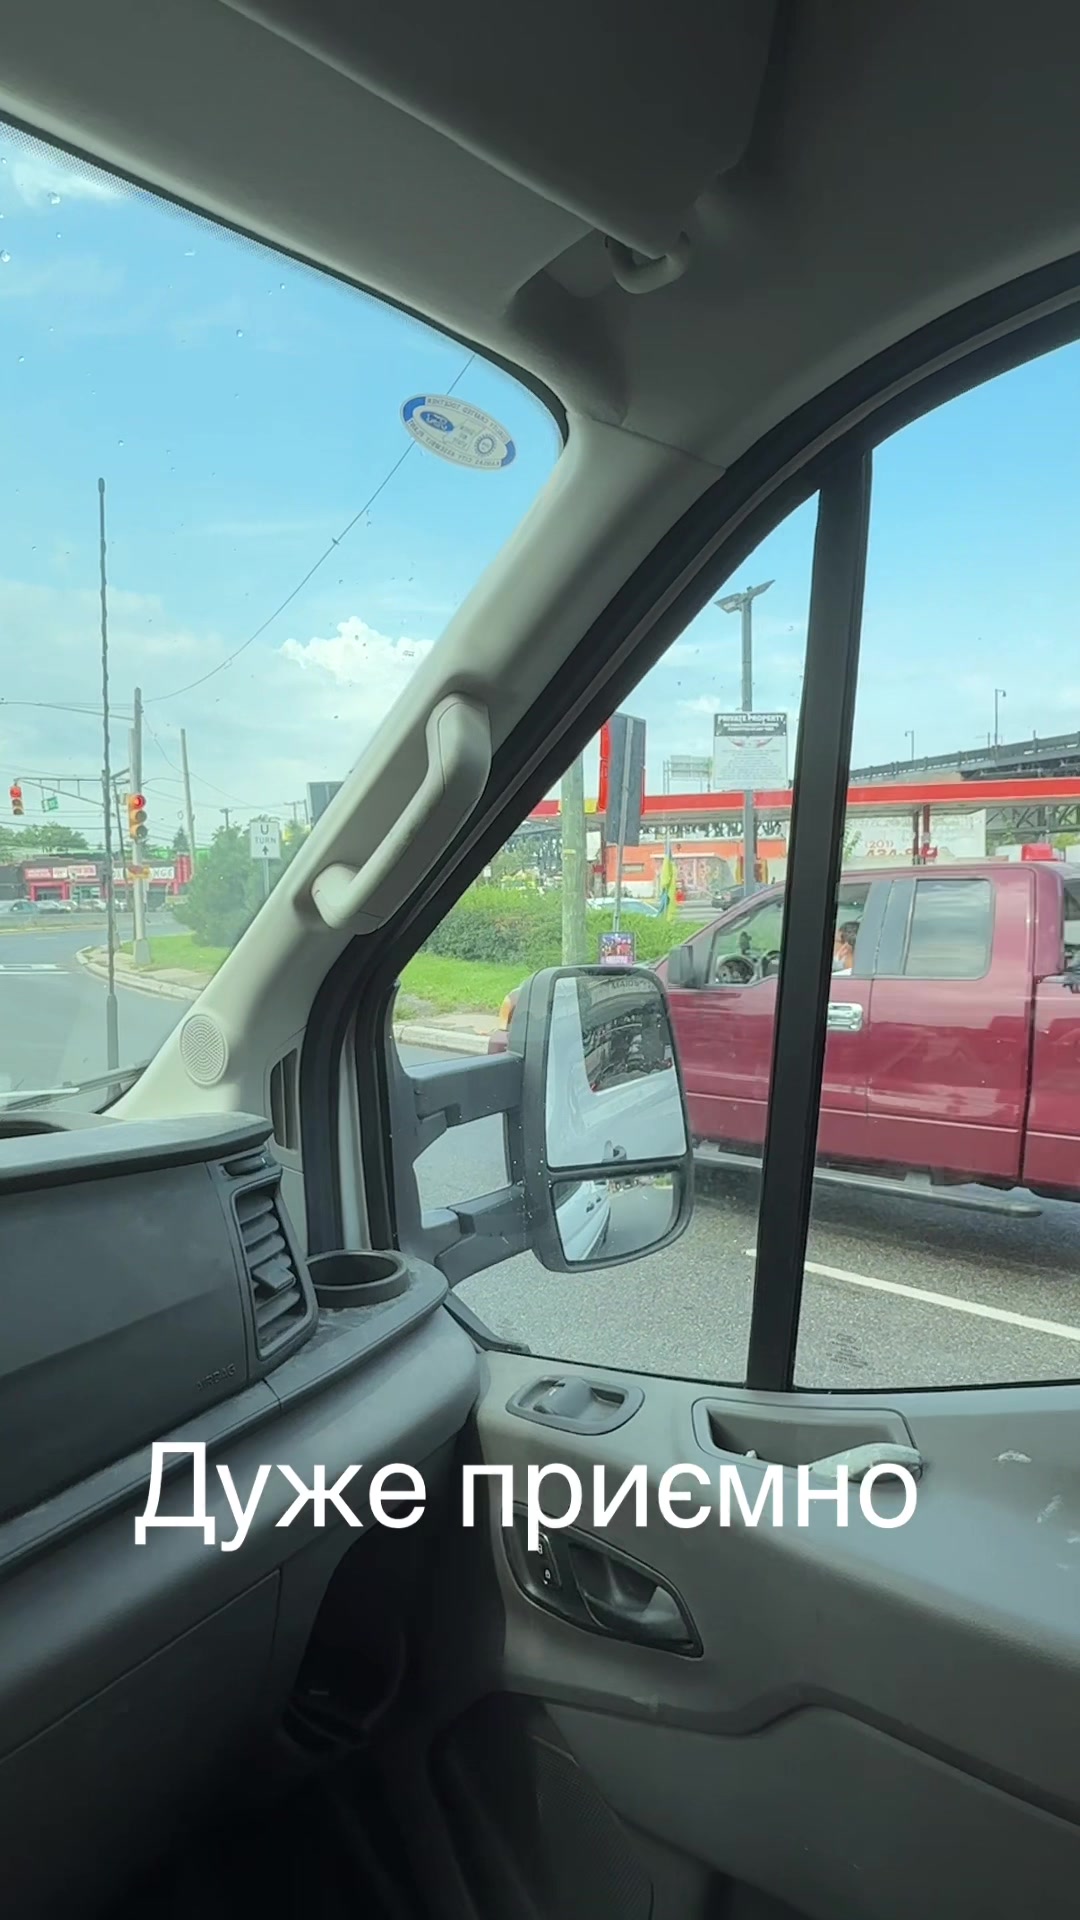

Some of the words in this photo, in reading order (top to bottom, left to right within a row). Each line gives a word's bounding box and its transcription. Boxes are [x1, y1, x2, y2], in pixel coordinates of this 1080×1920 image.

[747, 714, 785, 722] PROPERTY
[260, 824, 269, 835] U
[255, 836, 276, 845] TURN
[865, 839, 894, 848] (201)
[195, 1363, 236, 1391] AIRBAG
